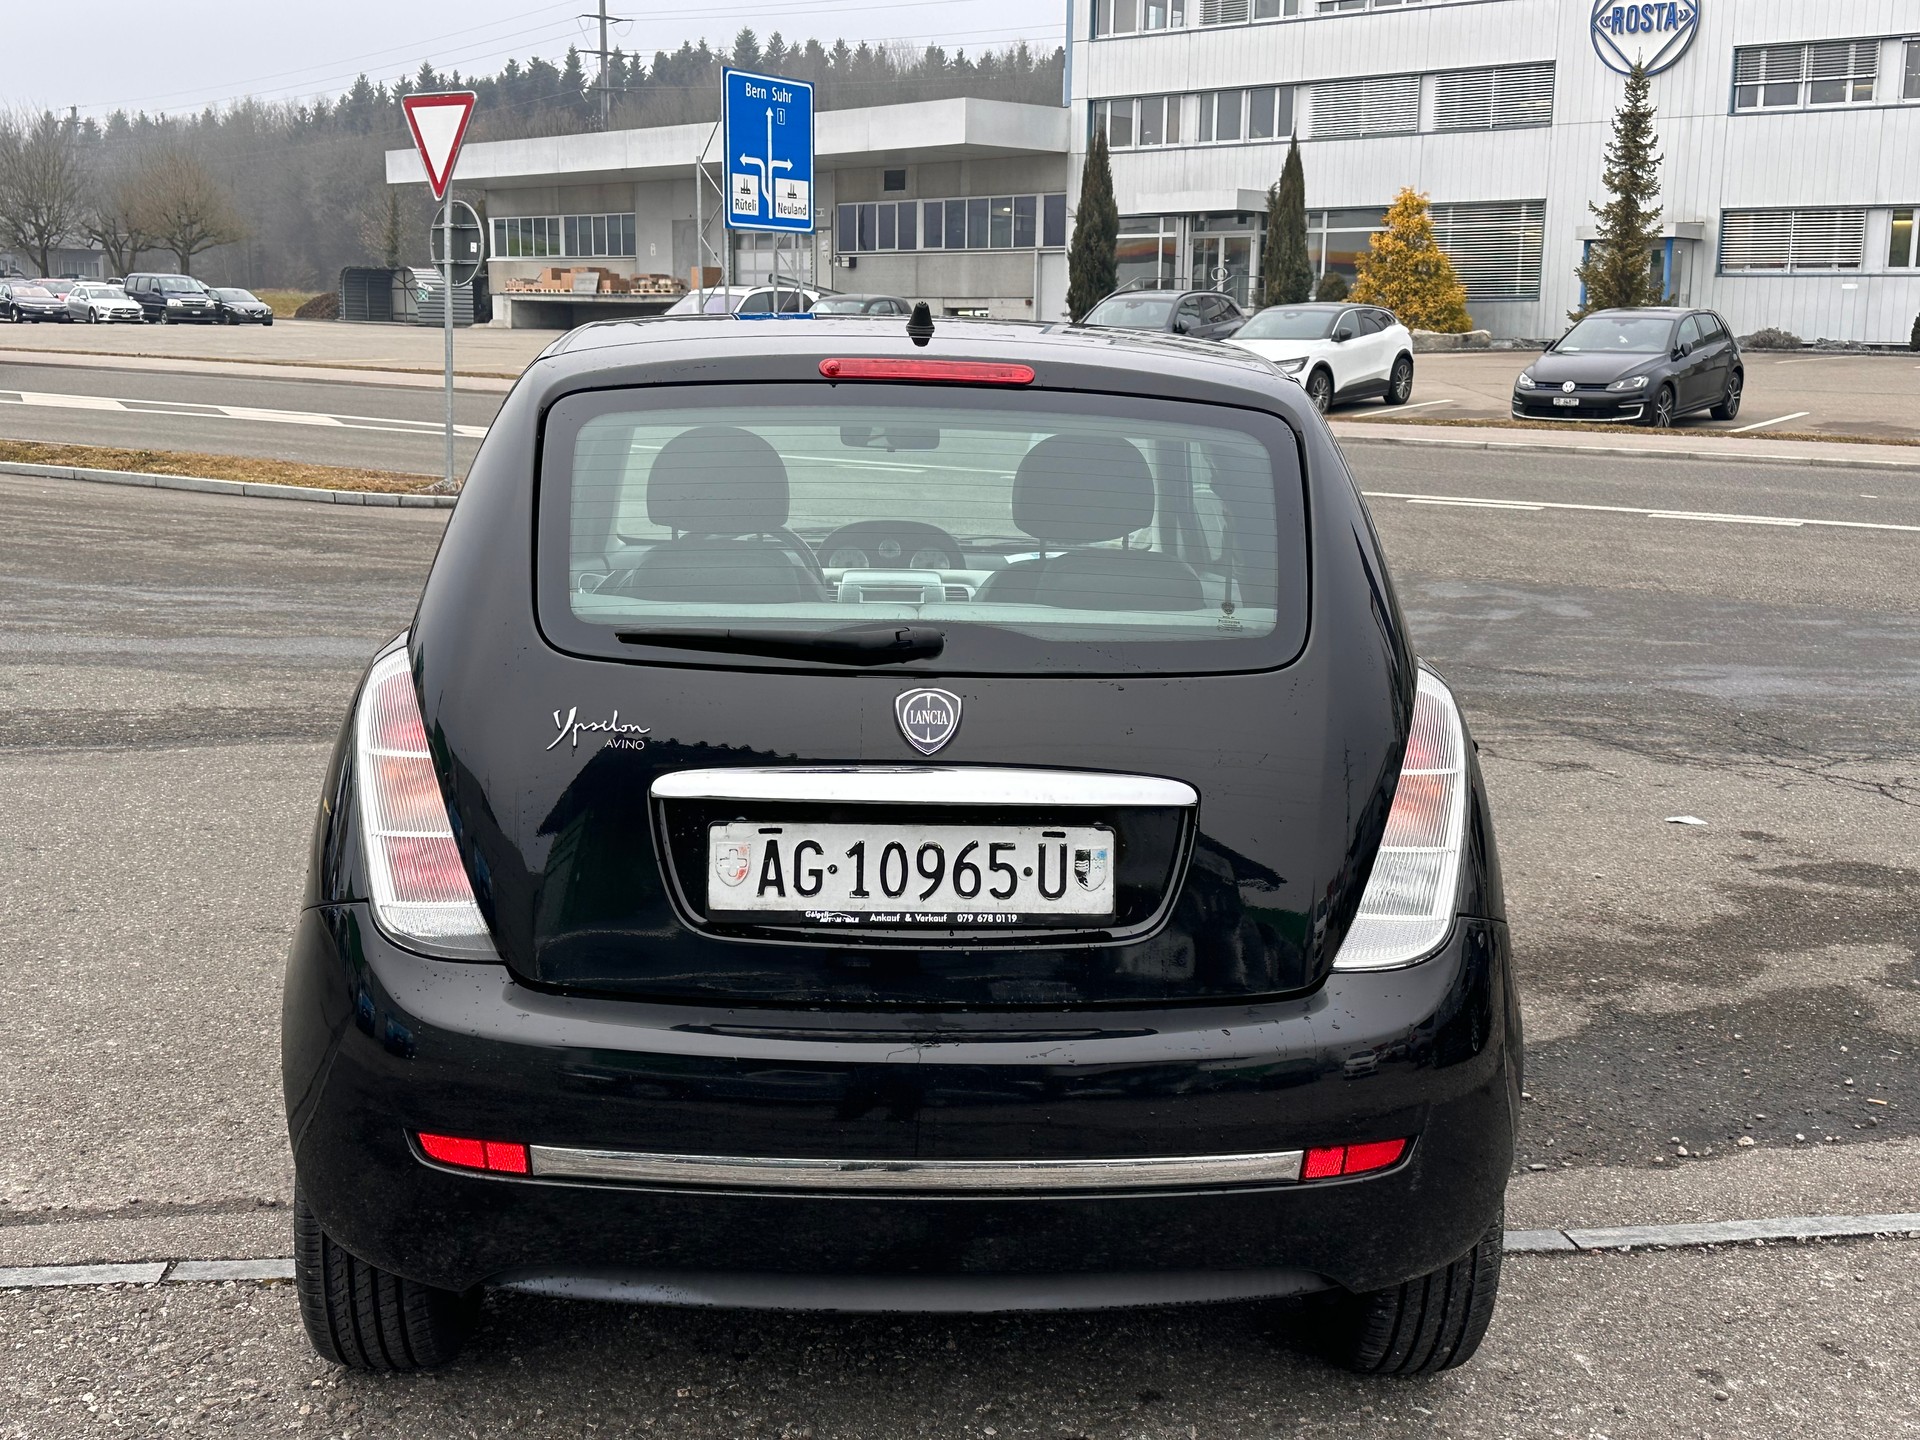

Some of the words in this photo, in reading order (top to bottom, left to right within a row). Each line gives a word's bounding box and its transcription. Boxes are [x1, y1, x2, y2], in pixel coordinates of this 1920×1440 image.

[745, 82, 767, 100] Bern
[772, 86, 792, 104] Suhr
[735, 198, 757, 212] Rüteli
[777, 202, 807, 216] Neuland
[910, 709, 949, 725] LANCIA
[546, 706, 651, 750] Ypsilon
[604, 738, 645, 750] AVINO
[869, 913, 901, 922] Ankauf
[904, 914, 912, 922] &
[915, 913, 948, 923] Verkauf
[957, 914, 973, 923] 079
[977, 914, 993, 923] 678
